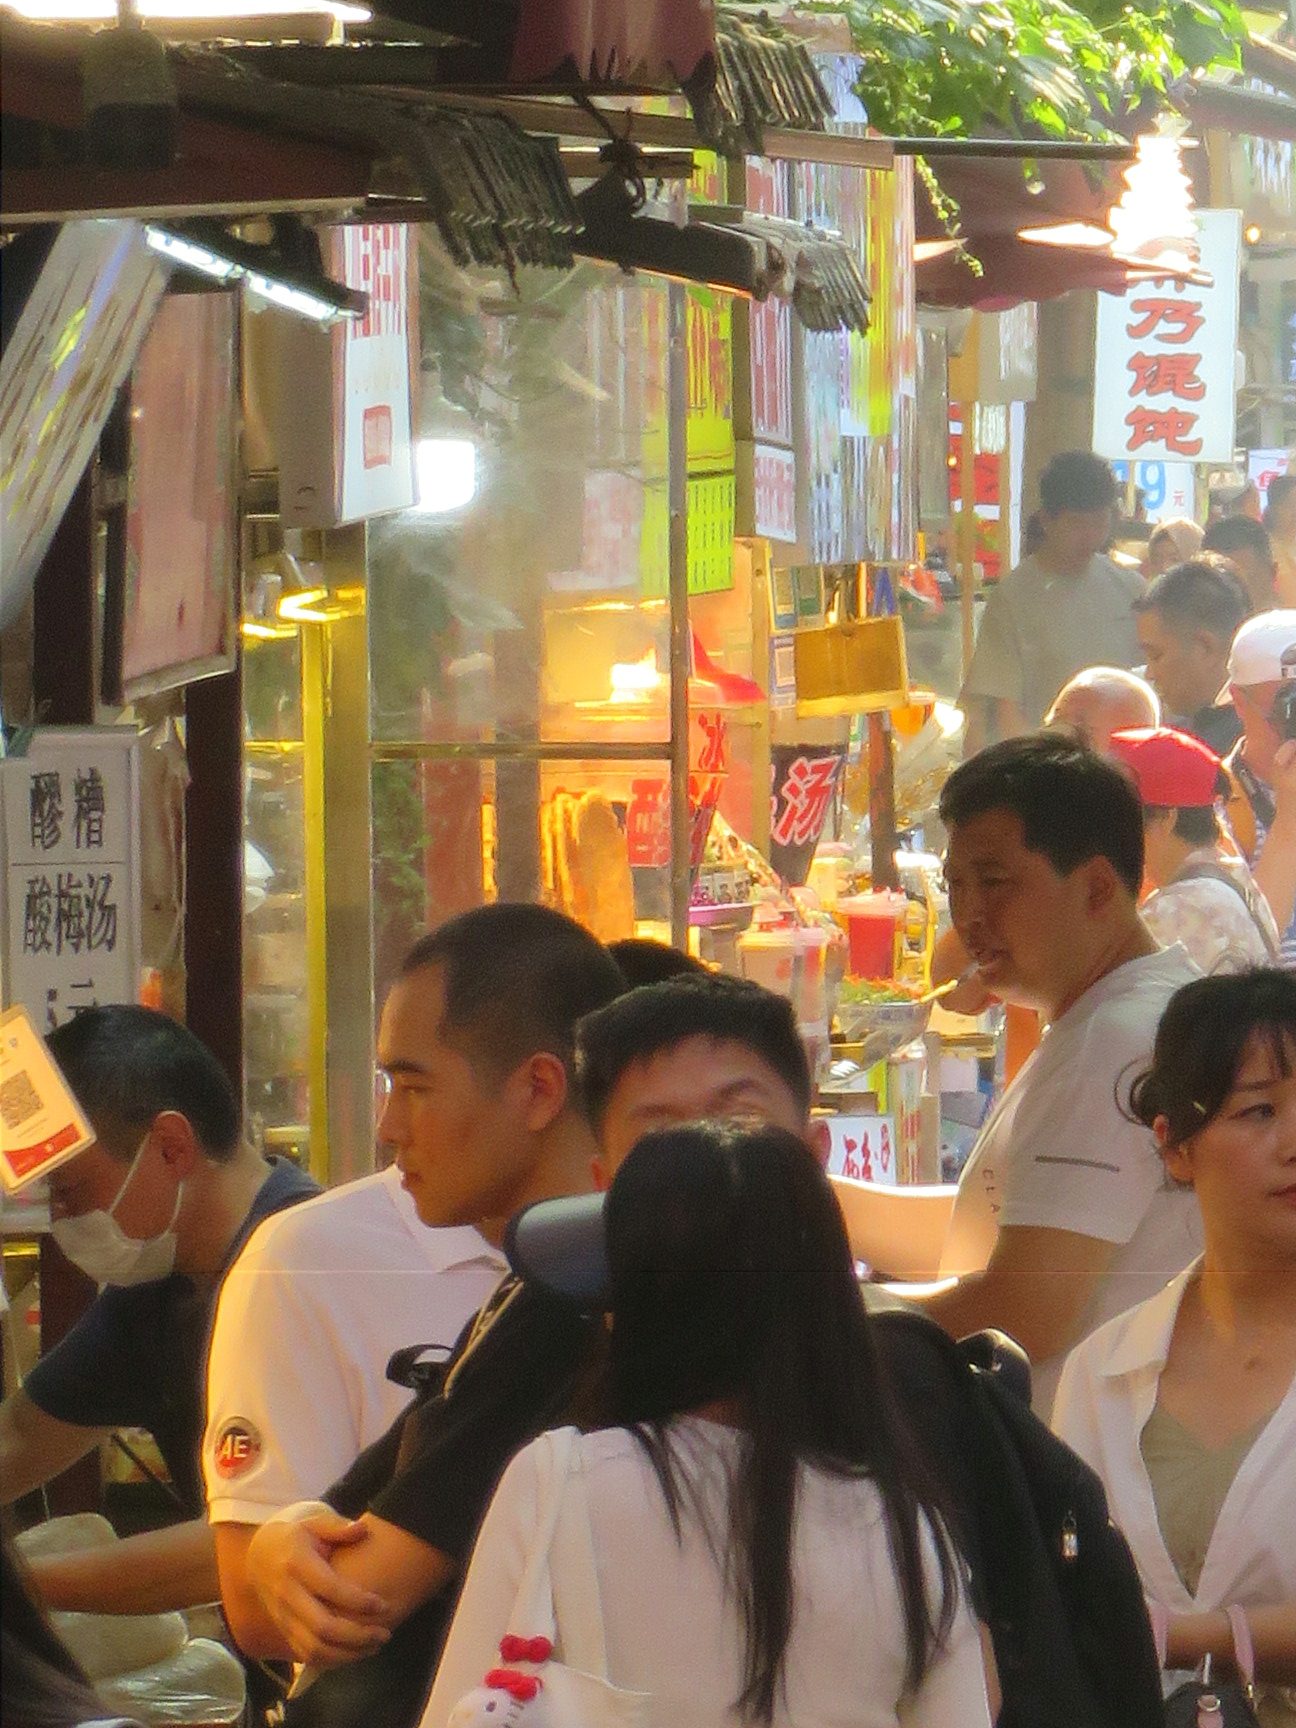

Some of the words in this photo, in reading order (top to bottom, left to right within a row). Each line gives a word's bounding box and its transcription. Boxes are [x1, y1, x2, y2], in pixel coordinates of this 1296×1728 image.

[1125, 275, 1206, 456] 乃馄饨
[29, 768, 106, 850] 醪糟
[23, 872, 118, 955] 酸梅汤
